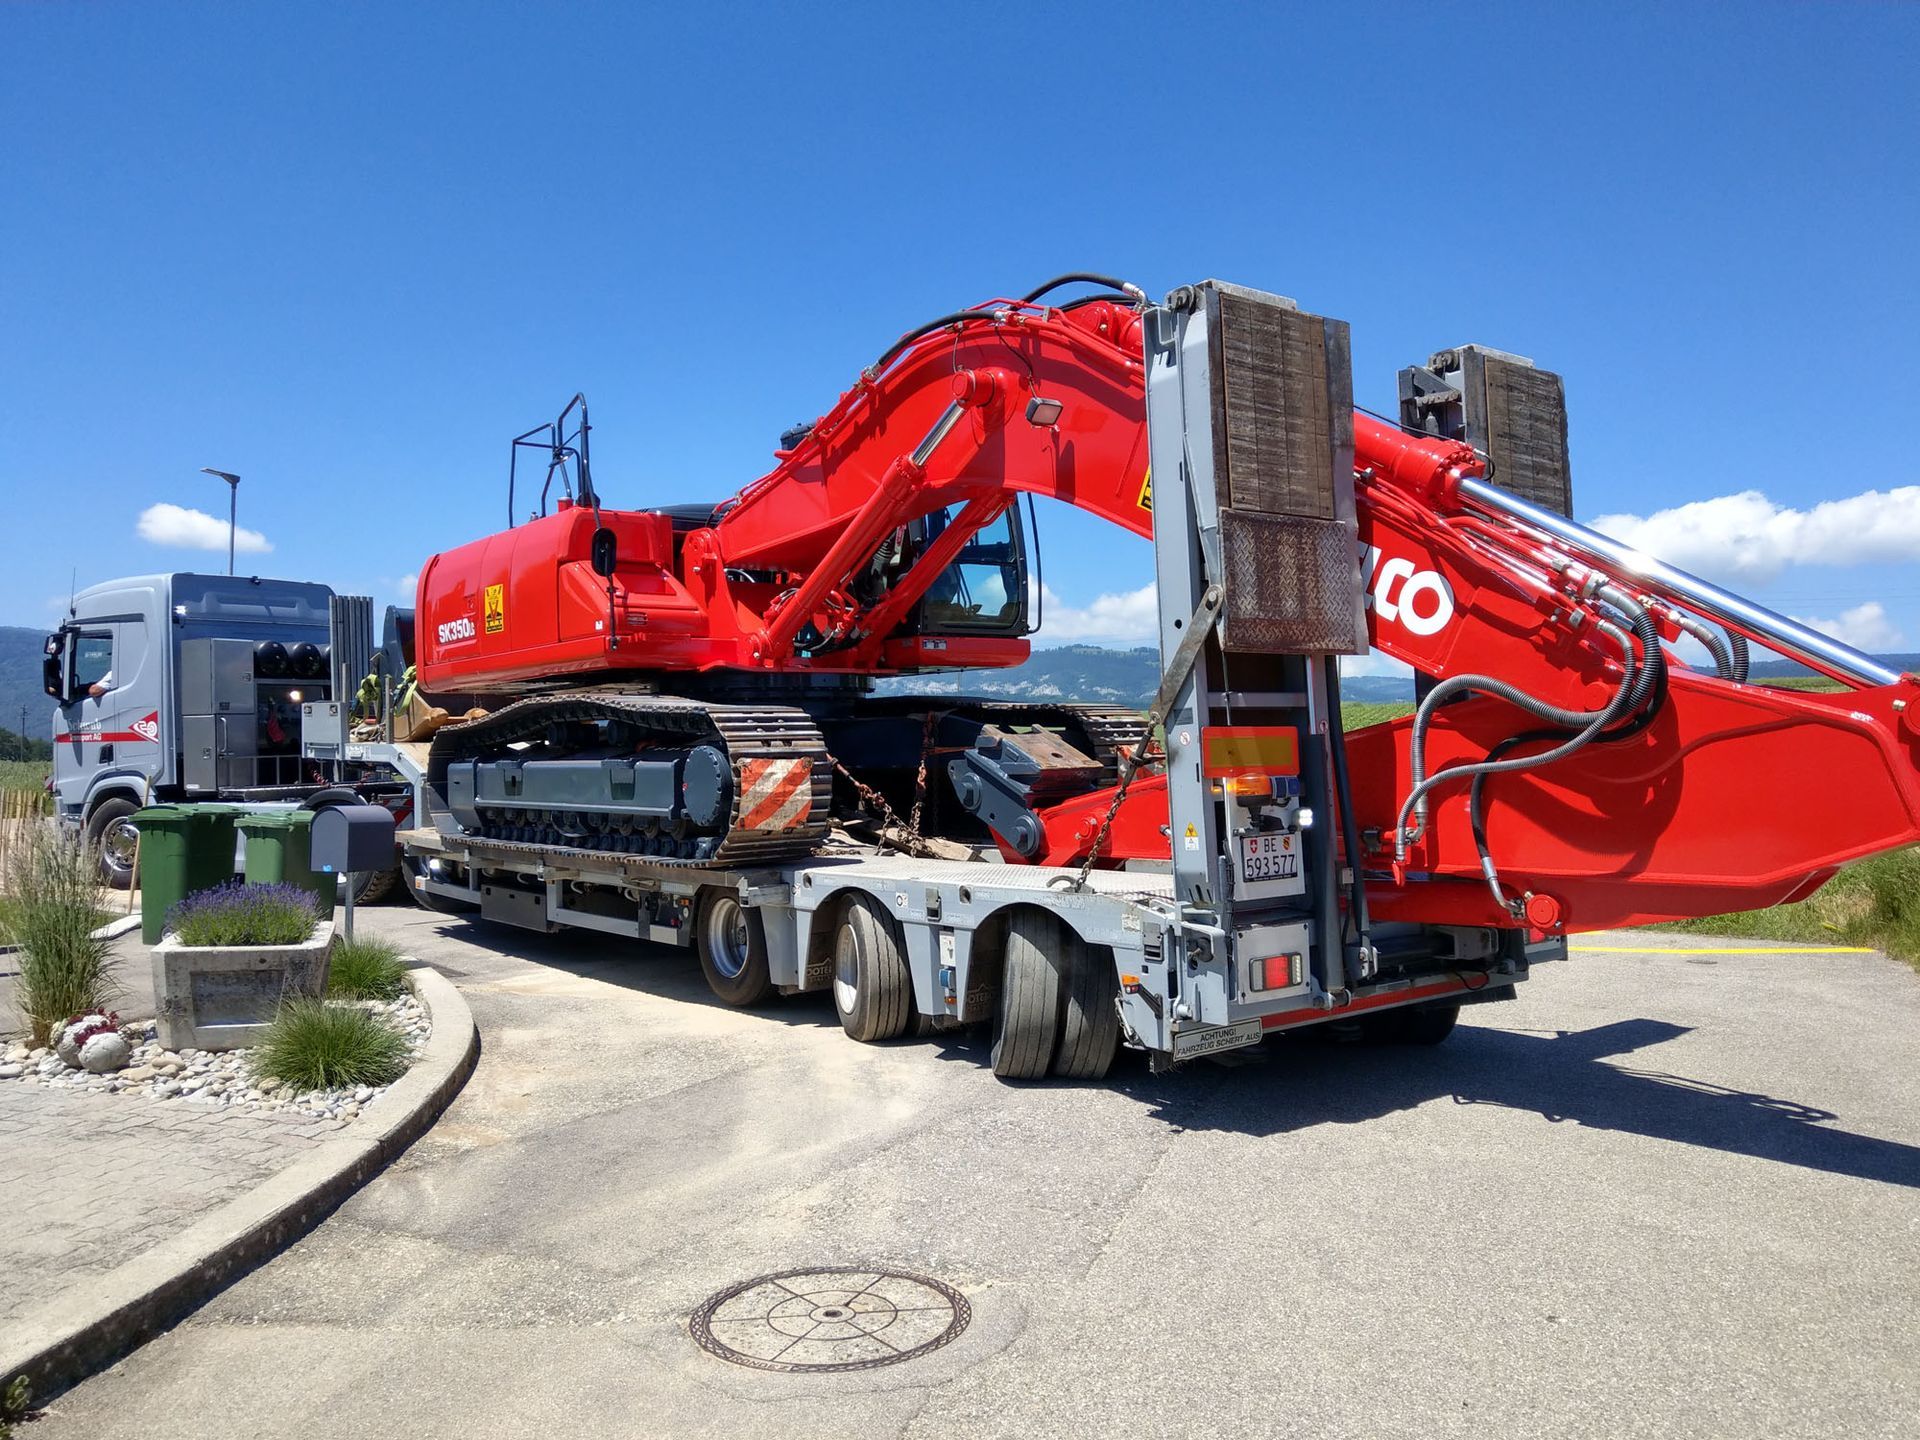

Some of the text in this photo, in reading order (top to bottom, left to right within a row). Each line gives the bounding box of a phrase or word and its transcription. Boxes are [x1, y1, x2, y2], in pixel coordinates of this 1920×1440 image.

[93, 732, 102, 741] AG
[1263, 838, 1278, 853] BE
[1200, 1027, 1238, 1043] ACHTUNG!
[1177, 1031, 1260, 1056] FAHRZEUG SCHERT AUS
